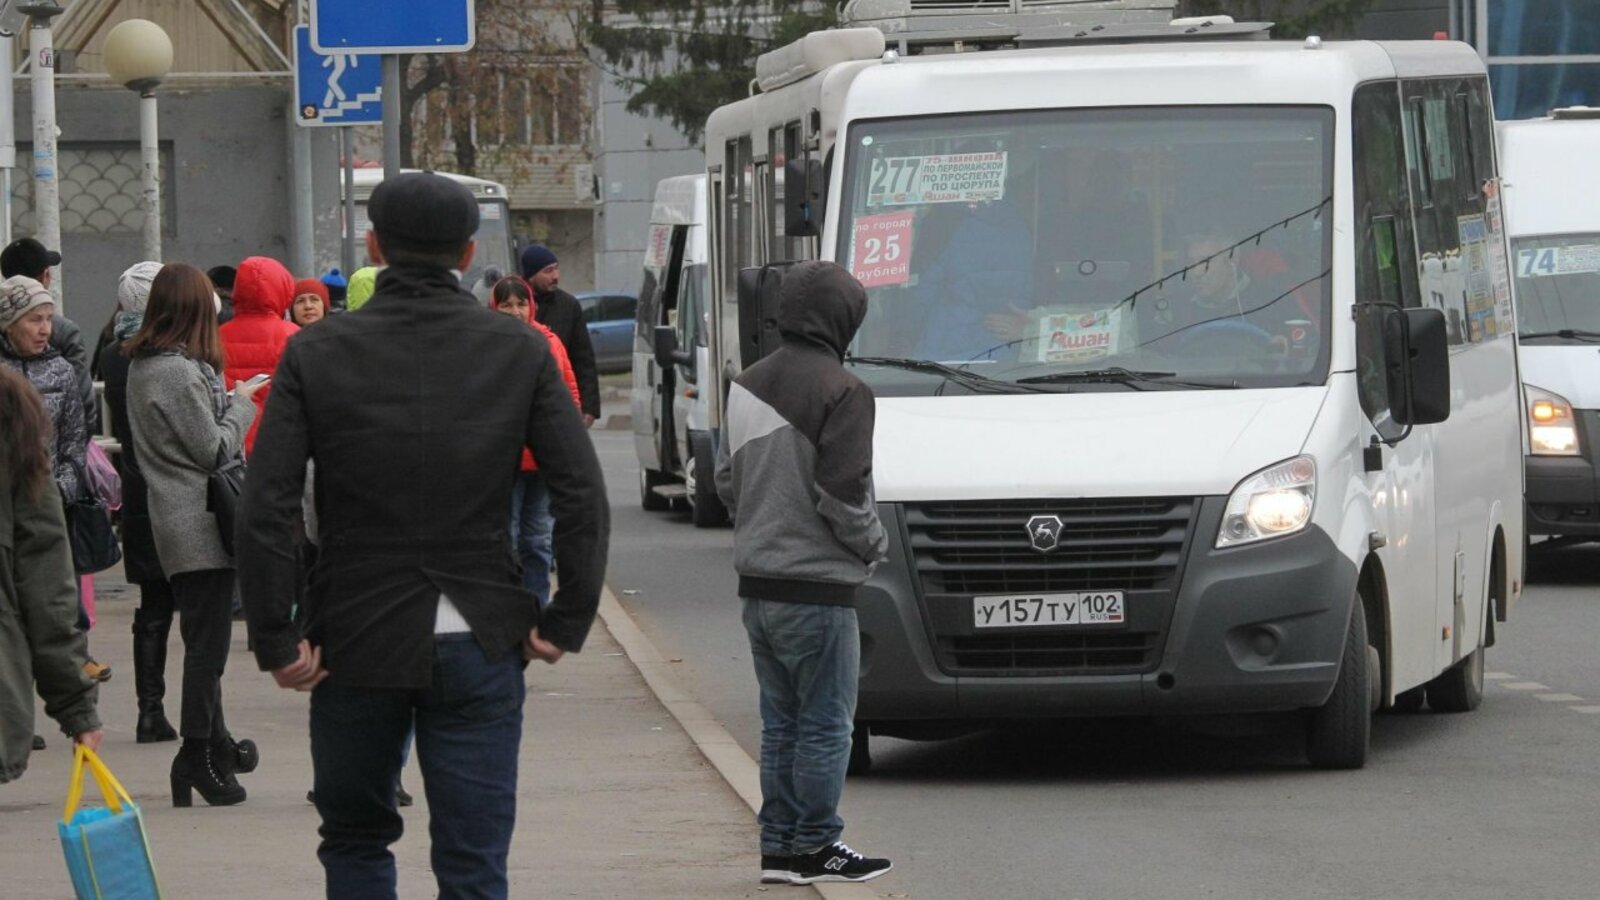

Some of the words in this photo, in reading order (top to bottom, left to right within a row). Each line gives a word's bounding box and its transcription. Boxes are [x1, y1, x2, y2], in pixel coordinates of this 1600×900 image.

[871, 159, 921, 194] 277
[923, 165, 936, 173] ПО
[923, 174, 937, 183] ПО
[940, 171, 1001, 181] ПРОСПЕКТУ
[931, 182, 948, 191] ПО
[951, 180, 1000, 192] ЦЮРУПА
[856, 223, 869, 232] по
[873, 217, 913, 231] городу
[863, 234, 901, 264] 25
[1521, 248, 1556, 275] 74
[857, 262, 908, 280] рублей
[1047, 331, 1110, 349] Ашан
[1082, 595, 1117, 613] 102
[1090, 613, 1108, 621] RUS
